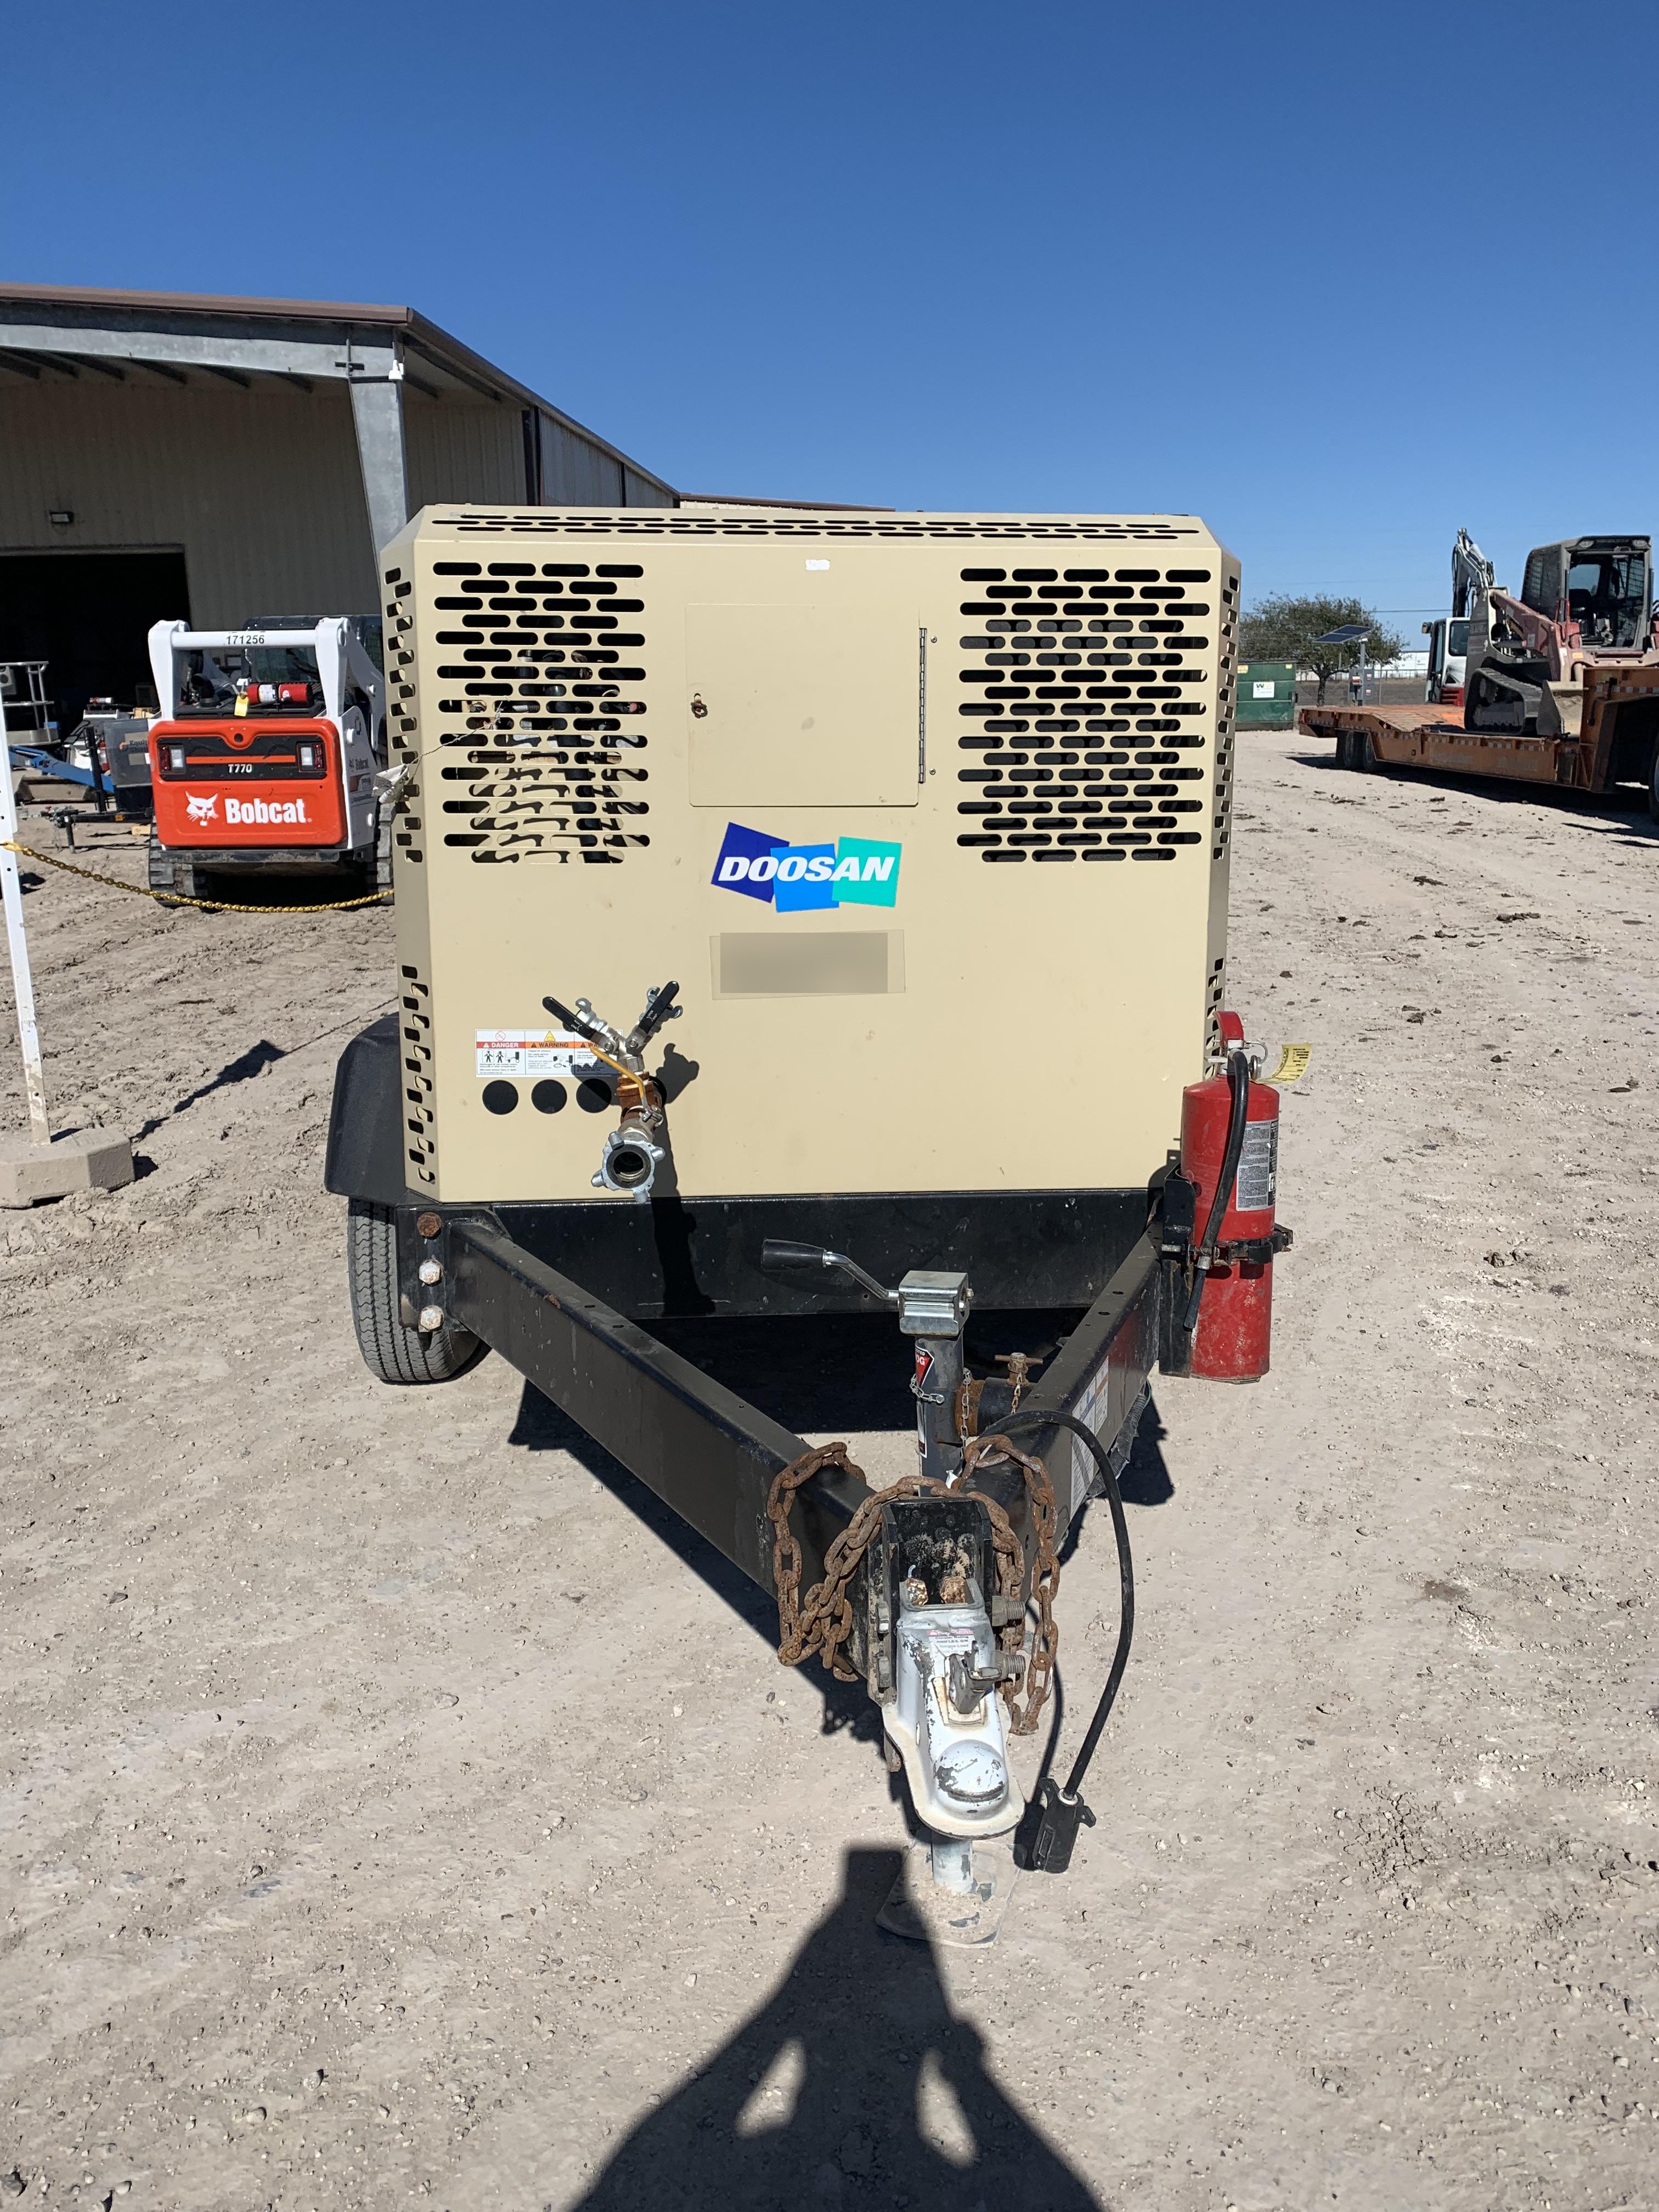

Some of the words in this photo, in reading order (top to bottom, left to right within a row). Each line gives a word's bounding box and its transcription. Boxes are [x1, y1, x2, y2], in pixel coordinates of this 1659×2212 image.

[226, 635, 264, 645] 171256
[228, 764, 252, 773] T770
[224, 798, 307, 824] Bobcat
[718, 856, 895, 882] DOOSAN
